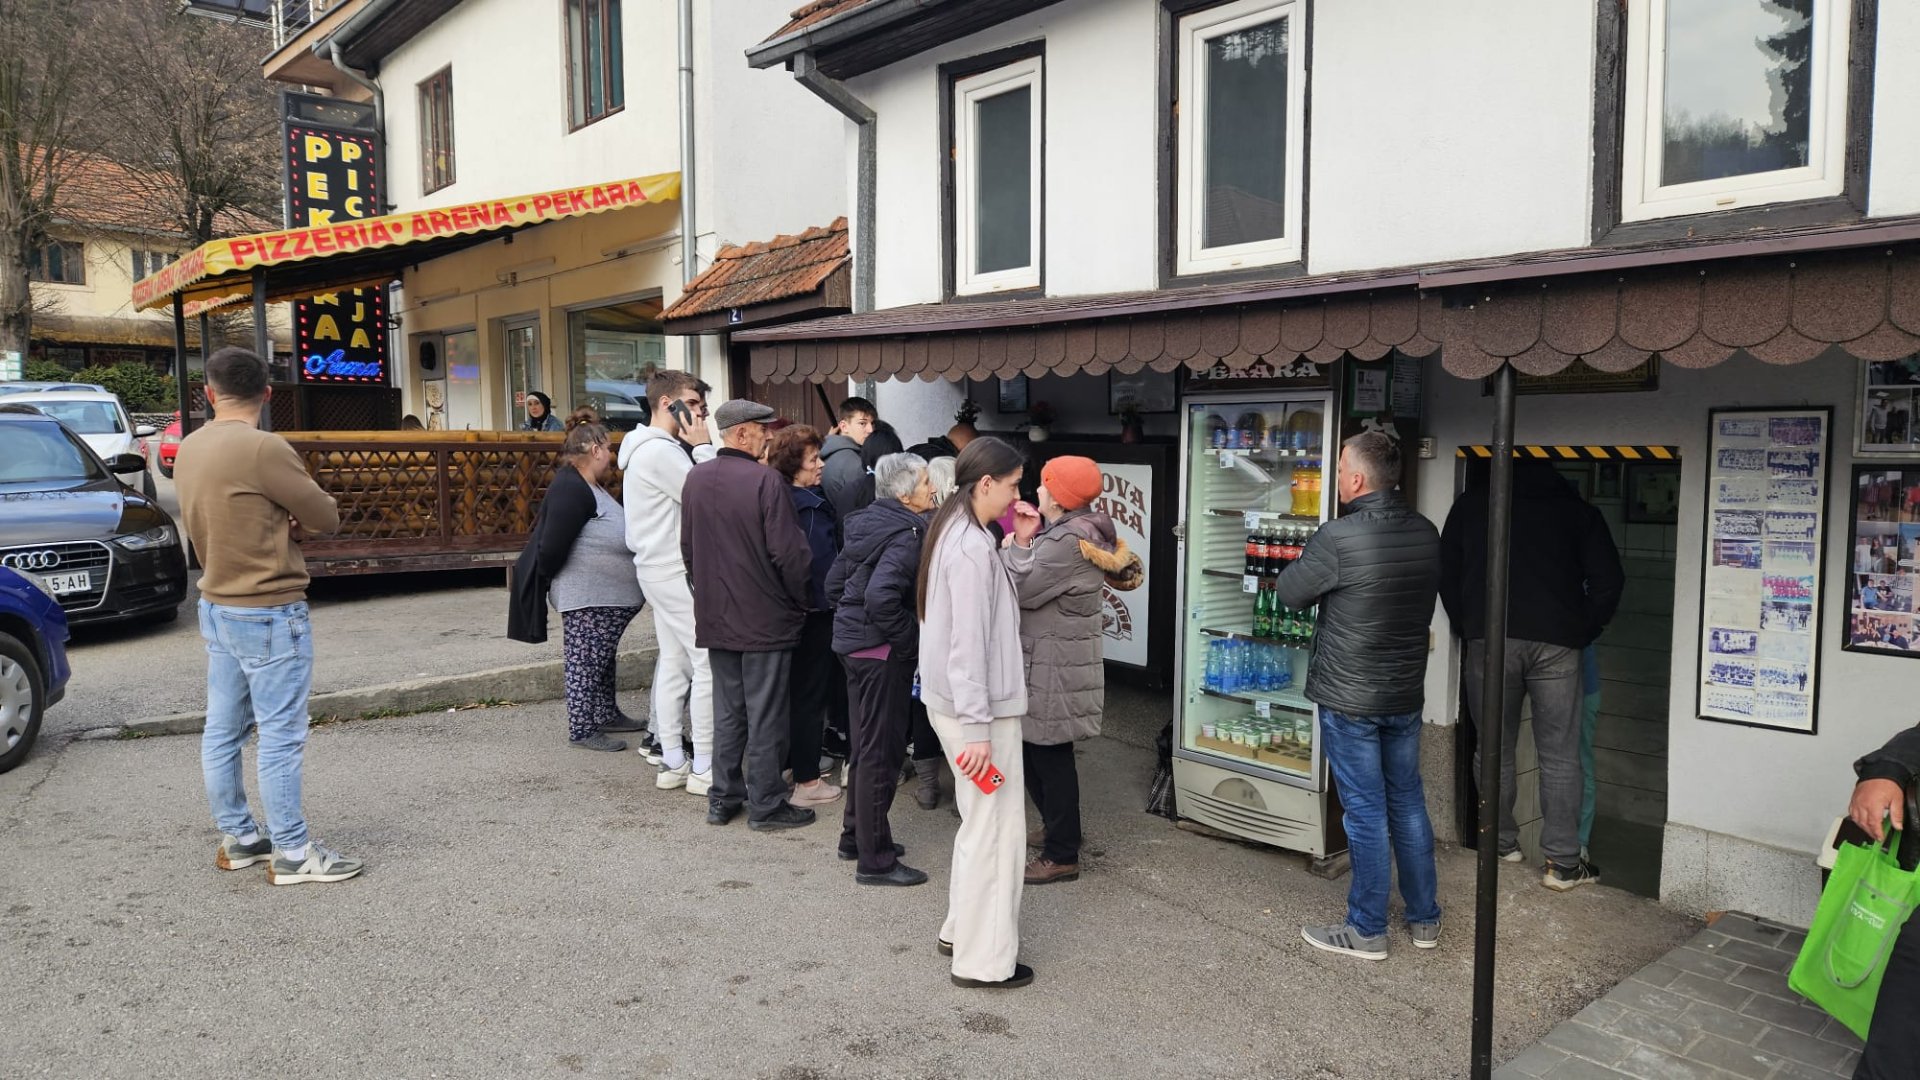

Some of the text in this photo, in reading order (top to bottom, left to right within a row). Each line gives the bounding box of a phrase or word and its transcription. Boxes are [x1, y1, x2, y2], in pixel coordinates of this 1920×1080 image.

[229, 181, 648, 266] PIZZERIA ARENA PEKARA
[732, 307, 738, 322] 2
[1102, 472, 1147, 515] OVA
